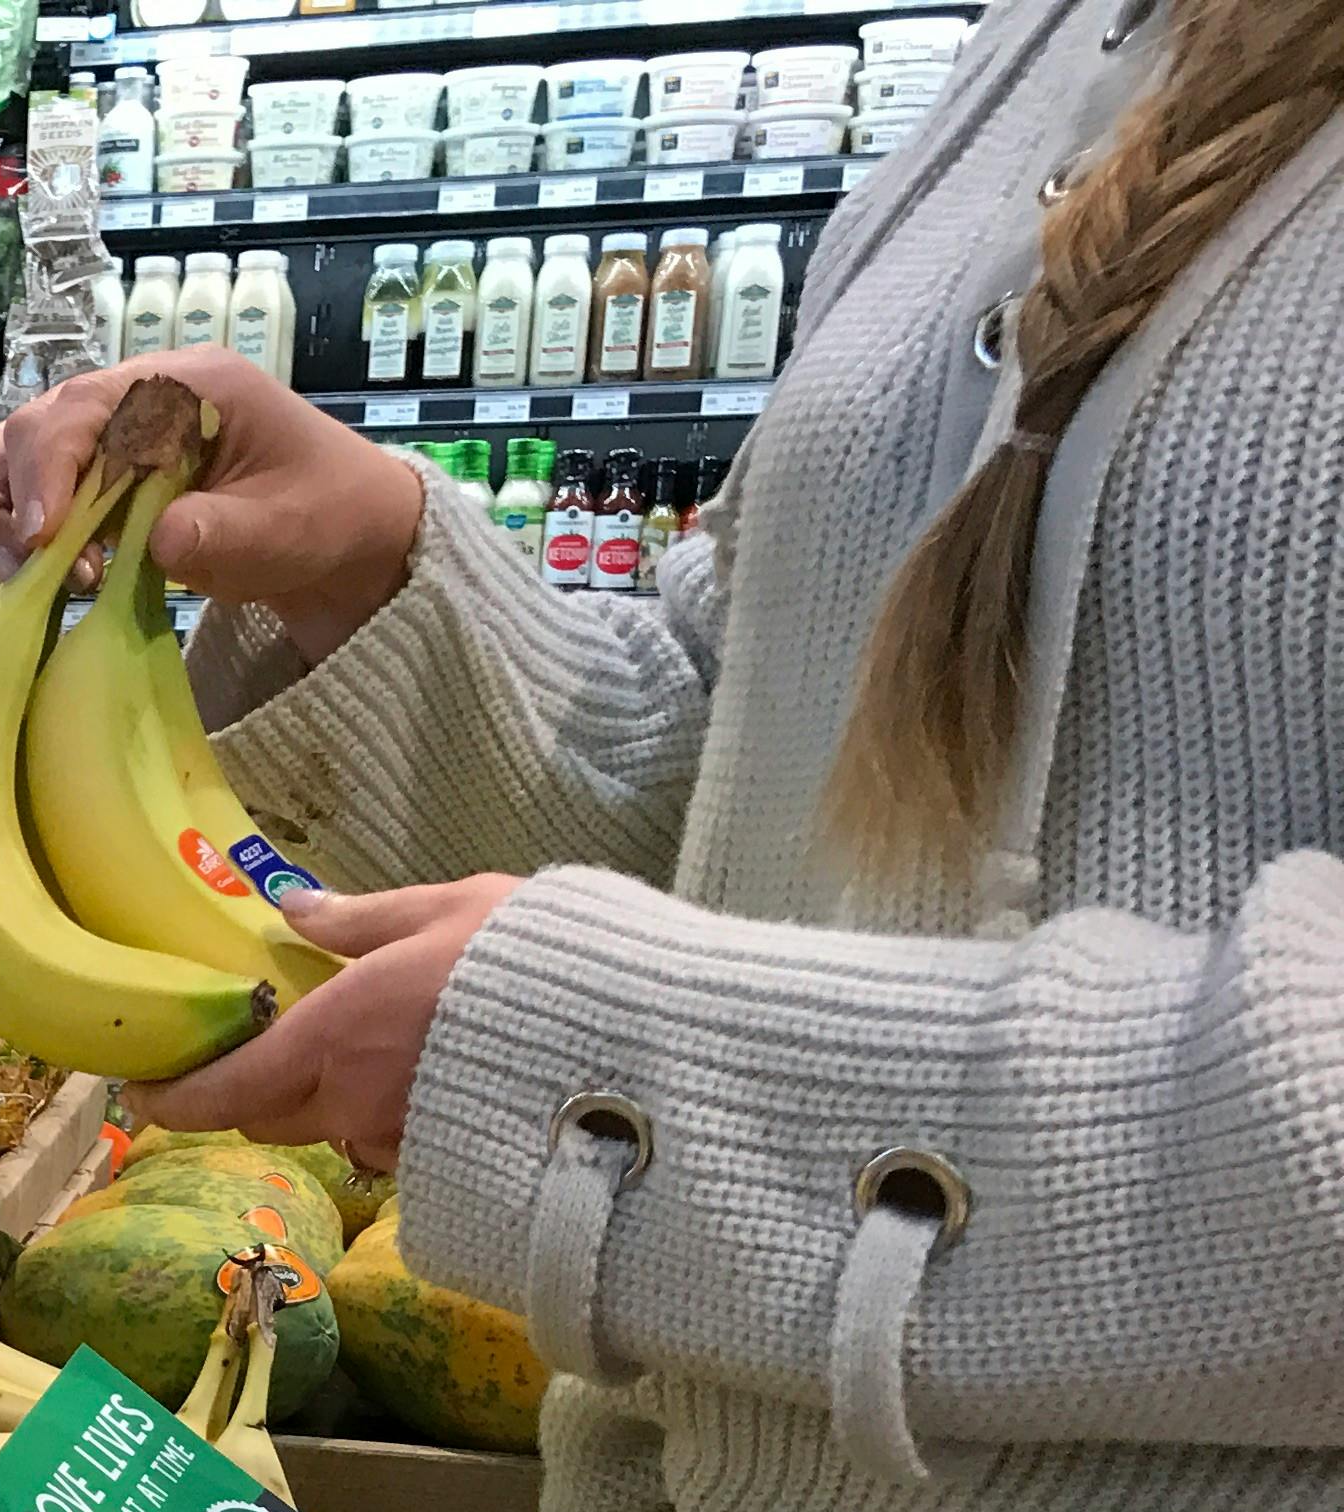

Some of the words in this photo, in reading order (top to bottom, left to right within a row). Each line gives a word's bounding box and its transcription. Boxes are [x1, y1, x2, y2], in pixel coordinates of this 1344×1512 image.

[238, 842, 264, 863] 4237
[73, 1393, 155, 1482] LIVES
[150, 1436, 196, 1484] TIME
